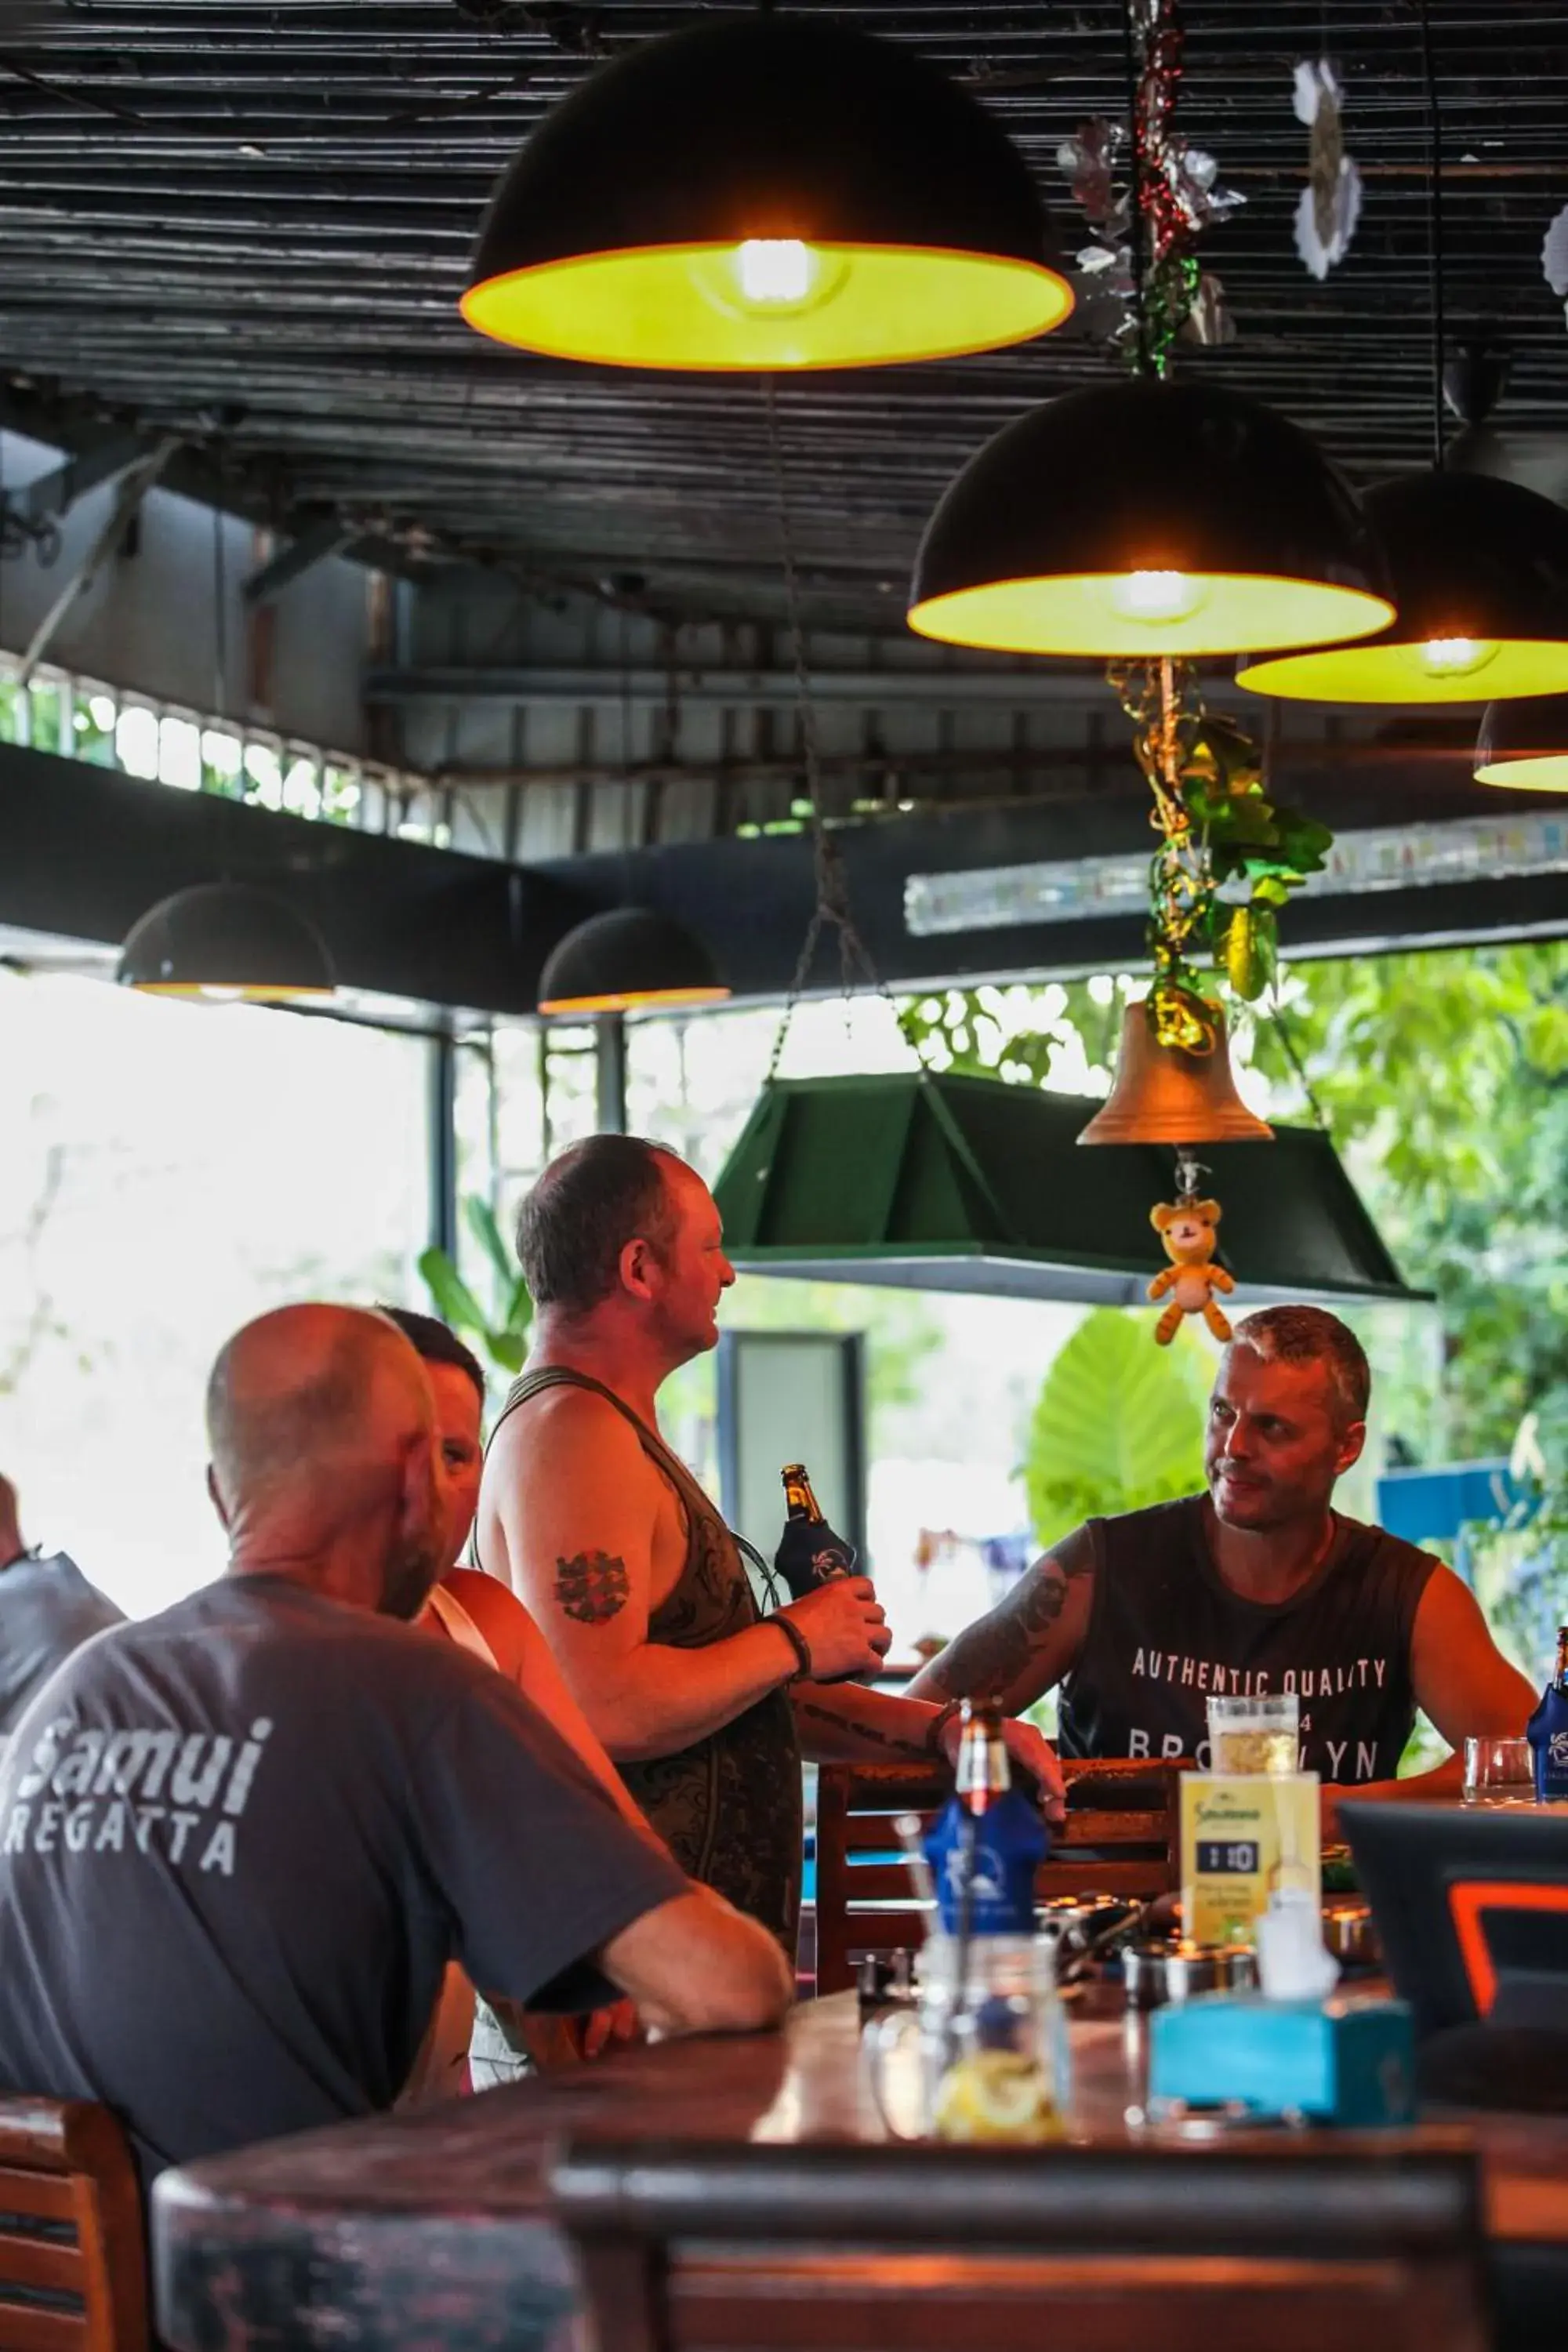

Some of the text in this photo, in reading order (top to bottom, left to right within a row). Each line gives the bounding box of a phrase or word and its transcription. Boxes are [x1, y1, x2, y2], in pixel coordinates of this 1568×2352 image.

[1132, 1647, 1385, 1697] AUTHENTIC QUALITY
[4, 1802, 234, 1876] REGATTA
